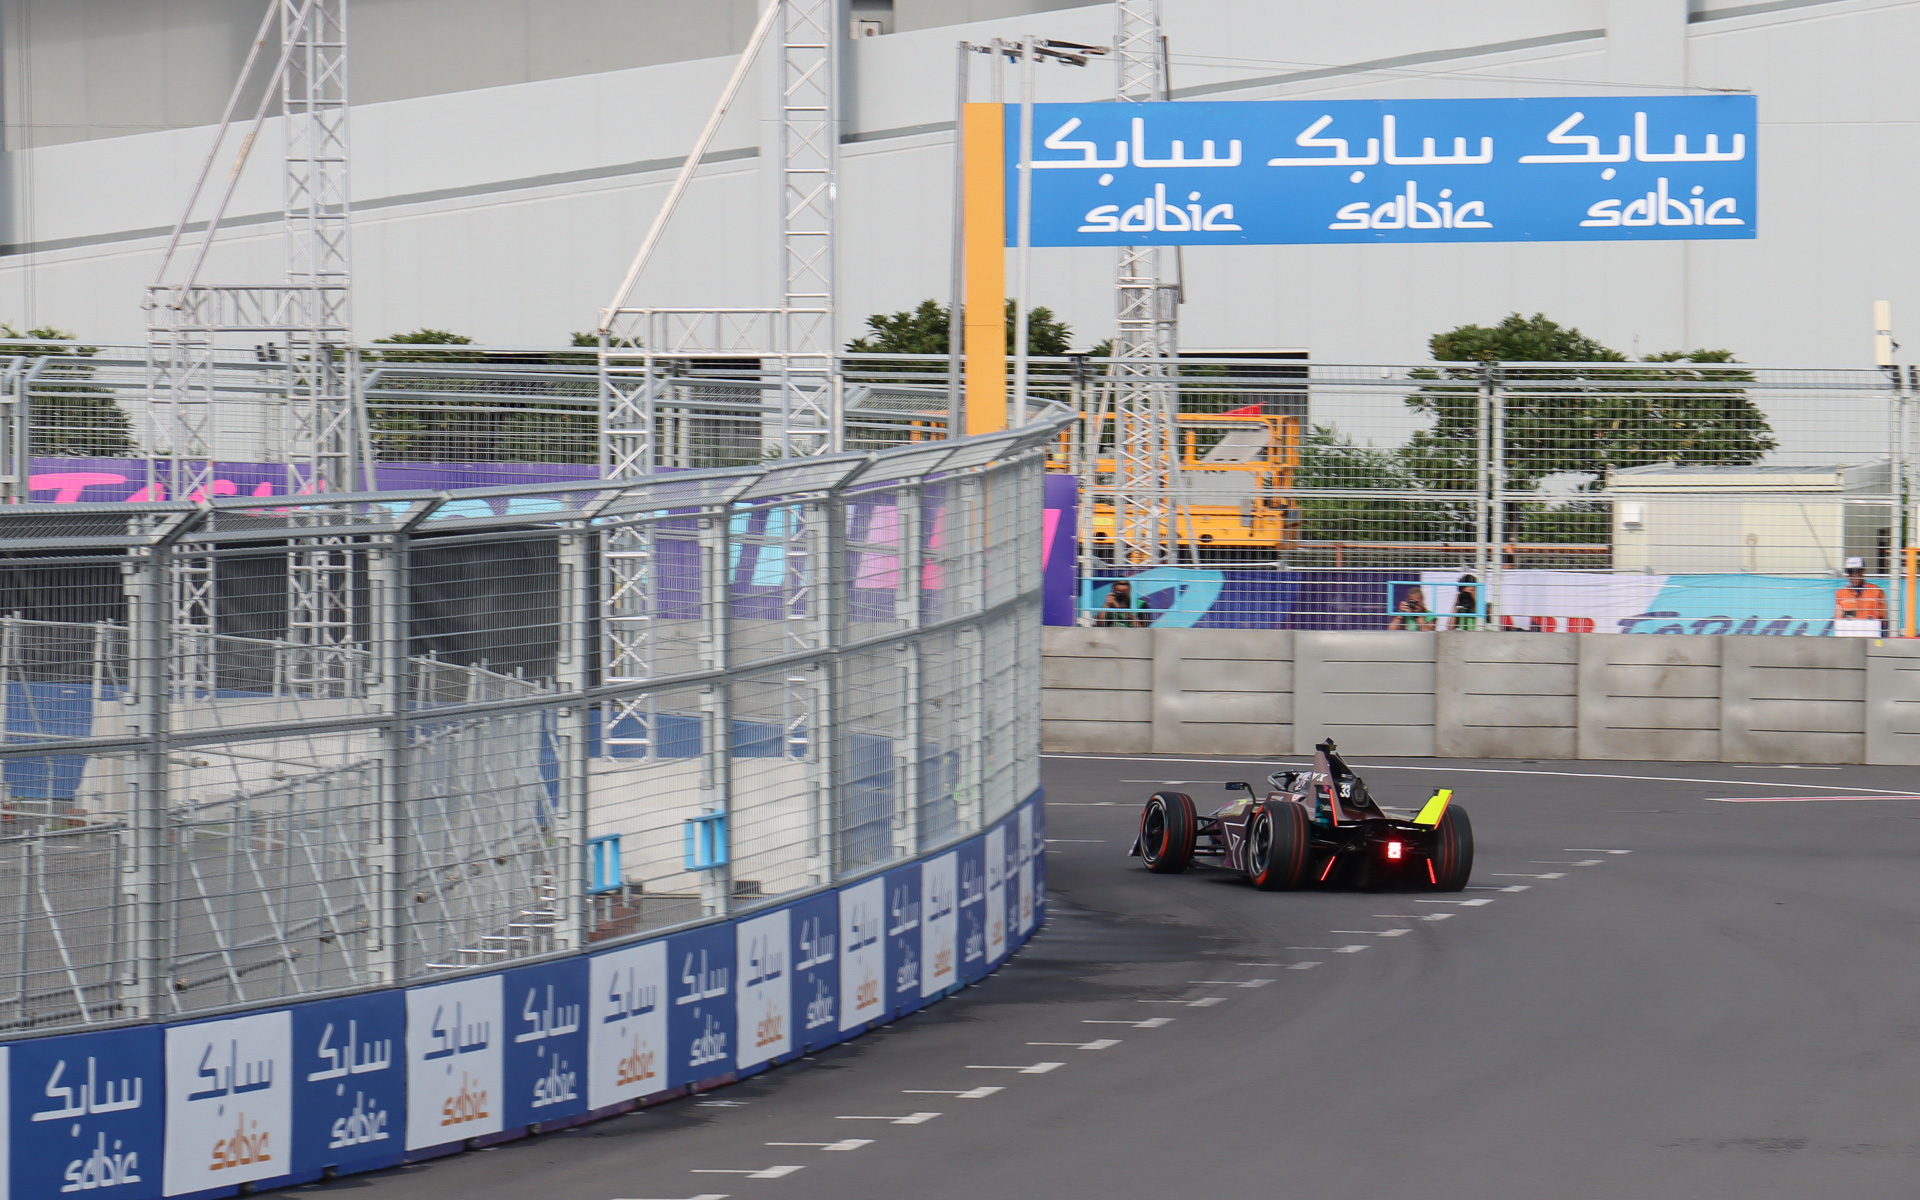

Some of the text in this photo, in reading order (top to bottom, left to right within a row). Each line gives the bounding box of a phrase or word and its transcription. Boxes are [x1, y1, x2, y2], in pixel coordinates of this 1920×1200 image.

[1267, 115, 1493, 184] سابك
[1519, 112, 1745, 181] سابك
[1078, 182, 1242, 232] sabic
[1329, 180, 1493, 230] sabic
[1580, 177, 1744, 228] sabic
[1340, 784, 1351, 798] 33
[187, 1039, 273, 1116] سابك
[307, 1020, 391, 1098] سابك
[31, 1057, 142, 1138] سابك
[329, 1091, 389, 1149] sabic
[62, 1132, 141, 1193] sabic
[210, 1112, 272, 1171] sabic
